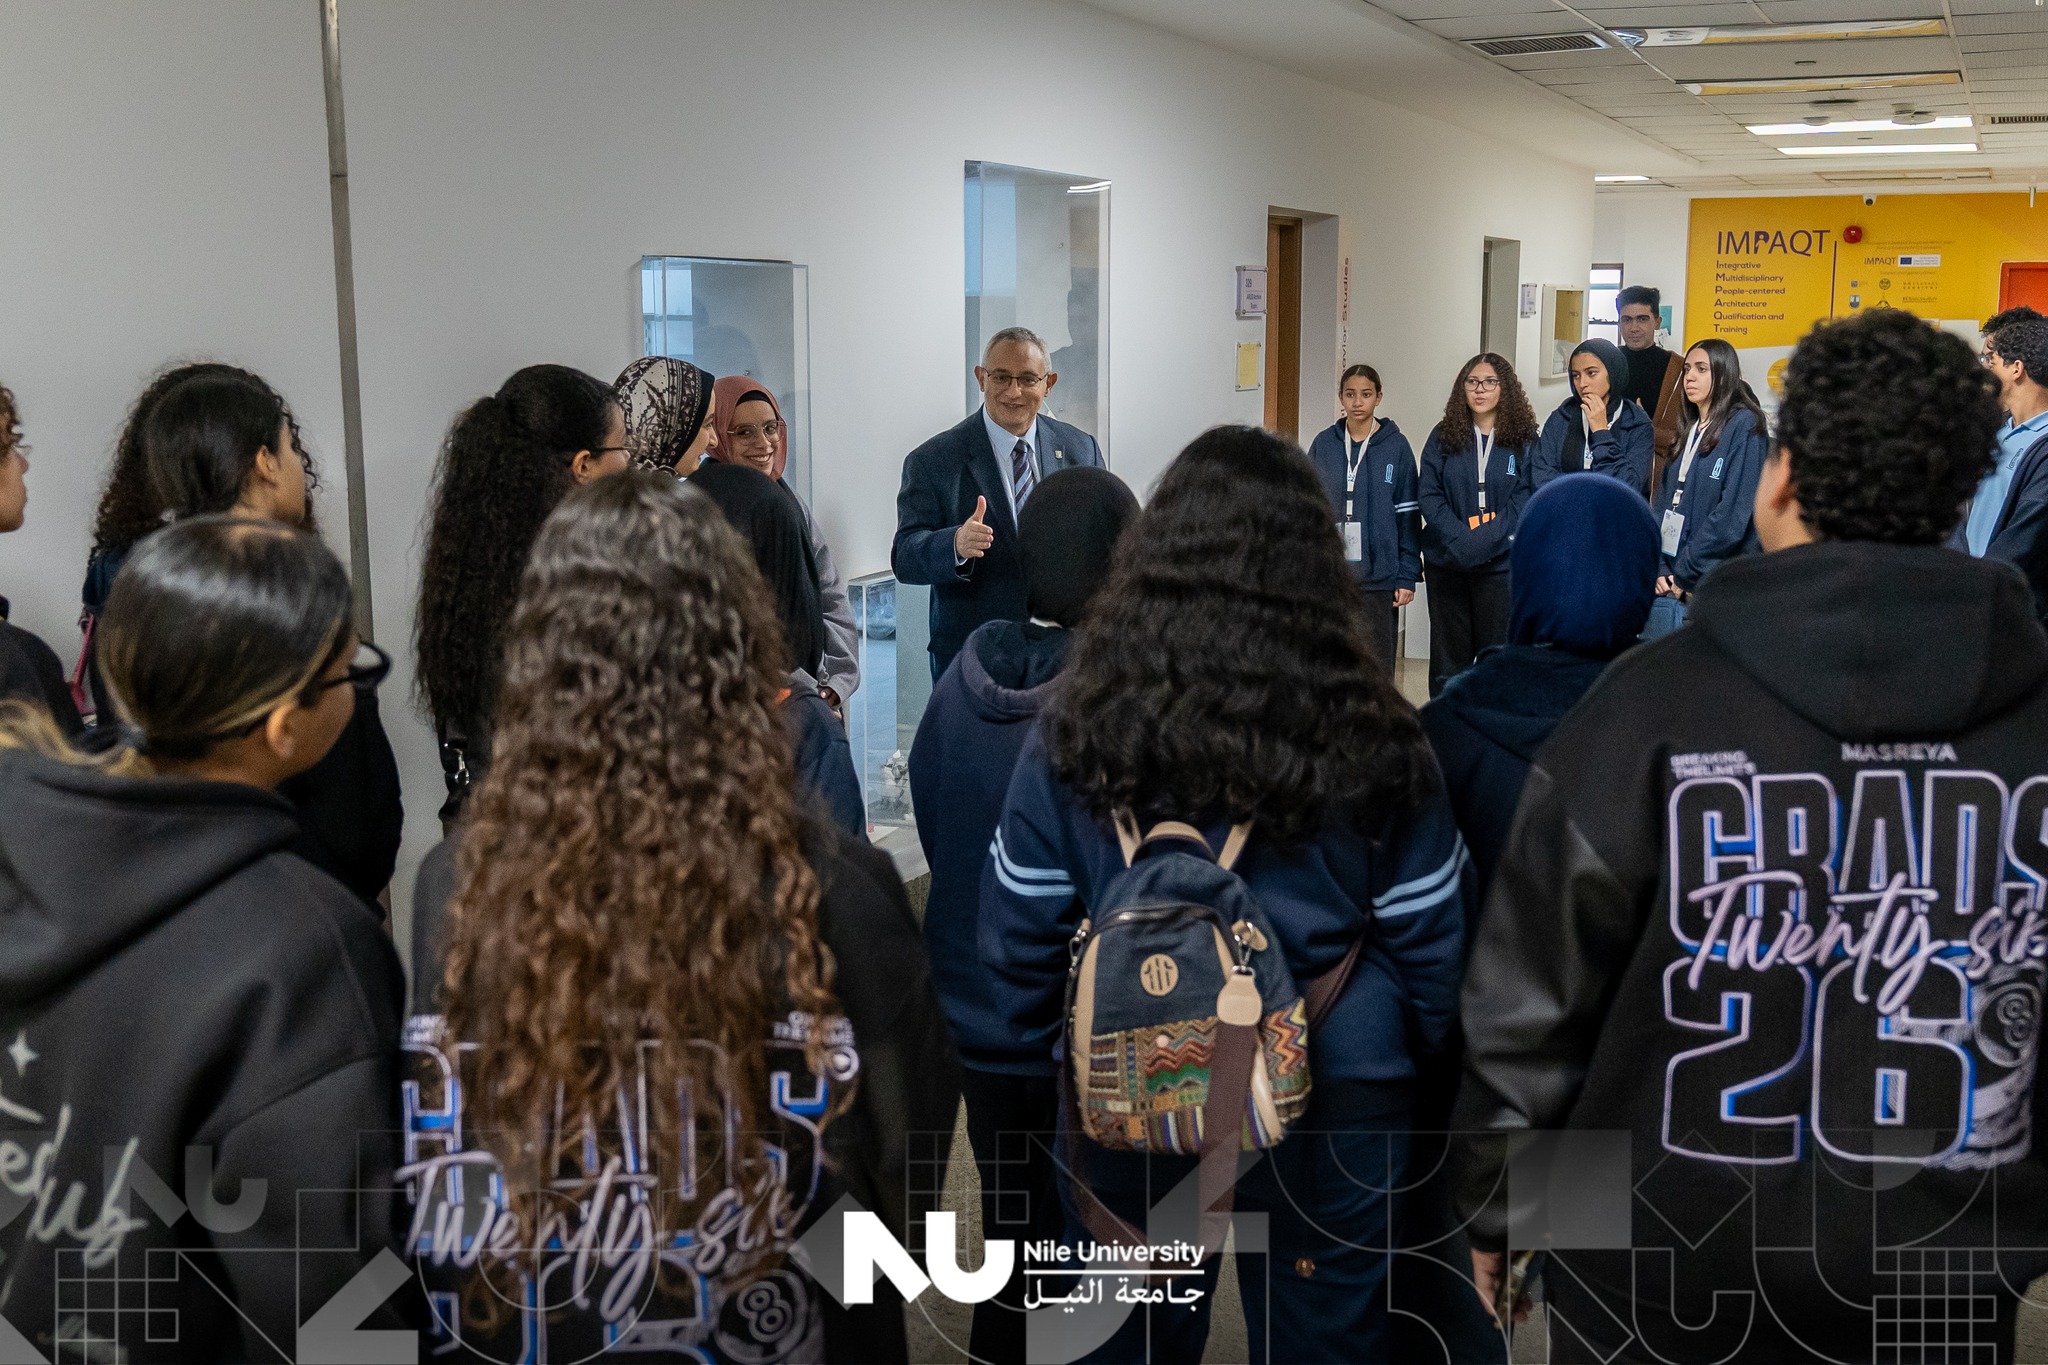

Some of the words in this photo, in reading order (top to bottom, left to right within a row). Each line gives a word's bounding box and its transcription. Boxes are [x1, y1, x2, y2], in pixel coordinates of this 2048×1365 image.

[1717, 229, 1831, 257] IMPAQT
[1716, 260, 1761, 271] Integrative
[1864, 256, 1897, 265] IMPAQT
[1715, 273, 1784, 283] Multidisciplinary
[1715, 285, 1786, 296] People-centered
[1714, 298, 1767, 308] Architecture
[1713, 311, 1767, 320] Qualification
[1768, 313, 1785, 321] and
[1713, 323, 1748, 335] Training
[1841, 741, 1958, 762] MASREYA
[1687, 871, 1948, 1014] Twenty
[1662, 956, 1977, 1166] 26
